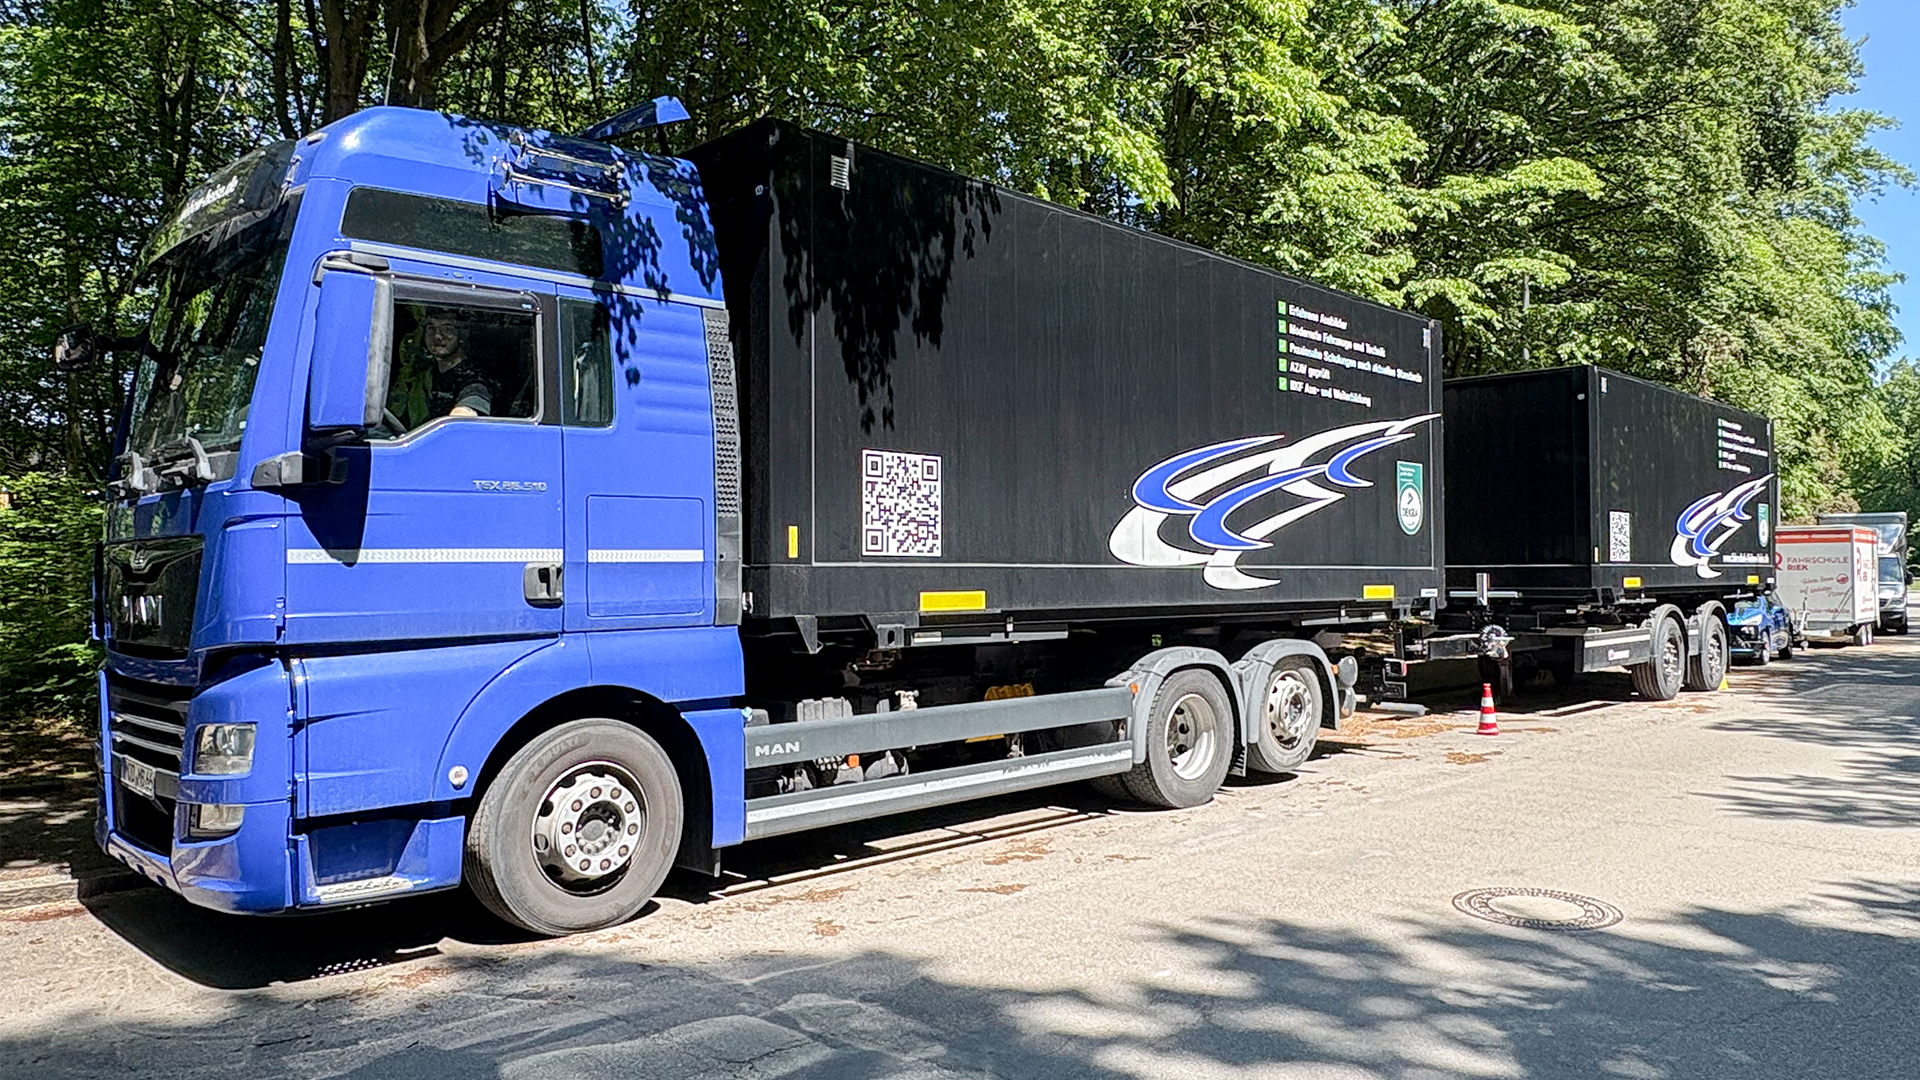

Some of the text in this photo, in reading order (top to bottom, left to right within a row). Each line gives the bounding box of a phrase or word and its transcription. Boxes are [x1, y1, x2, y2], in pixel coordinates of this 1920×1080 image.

[1320, 313, 1348, 331] Ausbilder
[1322, 331, 1353, 350] Fahrzeuge
[1353, 340, 1365, 353] und
[1365, 342, 1387, 359] Technik
[1289, 361, 1331, 380] AZAV geprüft
[1323, 350, 1357, 369] Schulungen
[1357, 359, 1372, 372] nach
[1372, 361, 1396, 378] aktuellen
[1396, 368, 1423, 384] Standards
[1289, 380, 1304, 393] BKF
[1321, 387, 1333, 399] und
[1333, 387, 1372, 408] Weiterbildung
[1786, 555, 1849, 564] FAHRSCHULE
[754, 741, 800, 757] MAN
